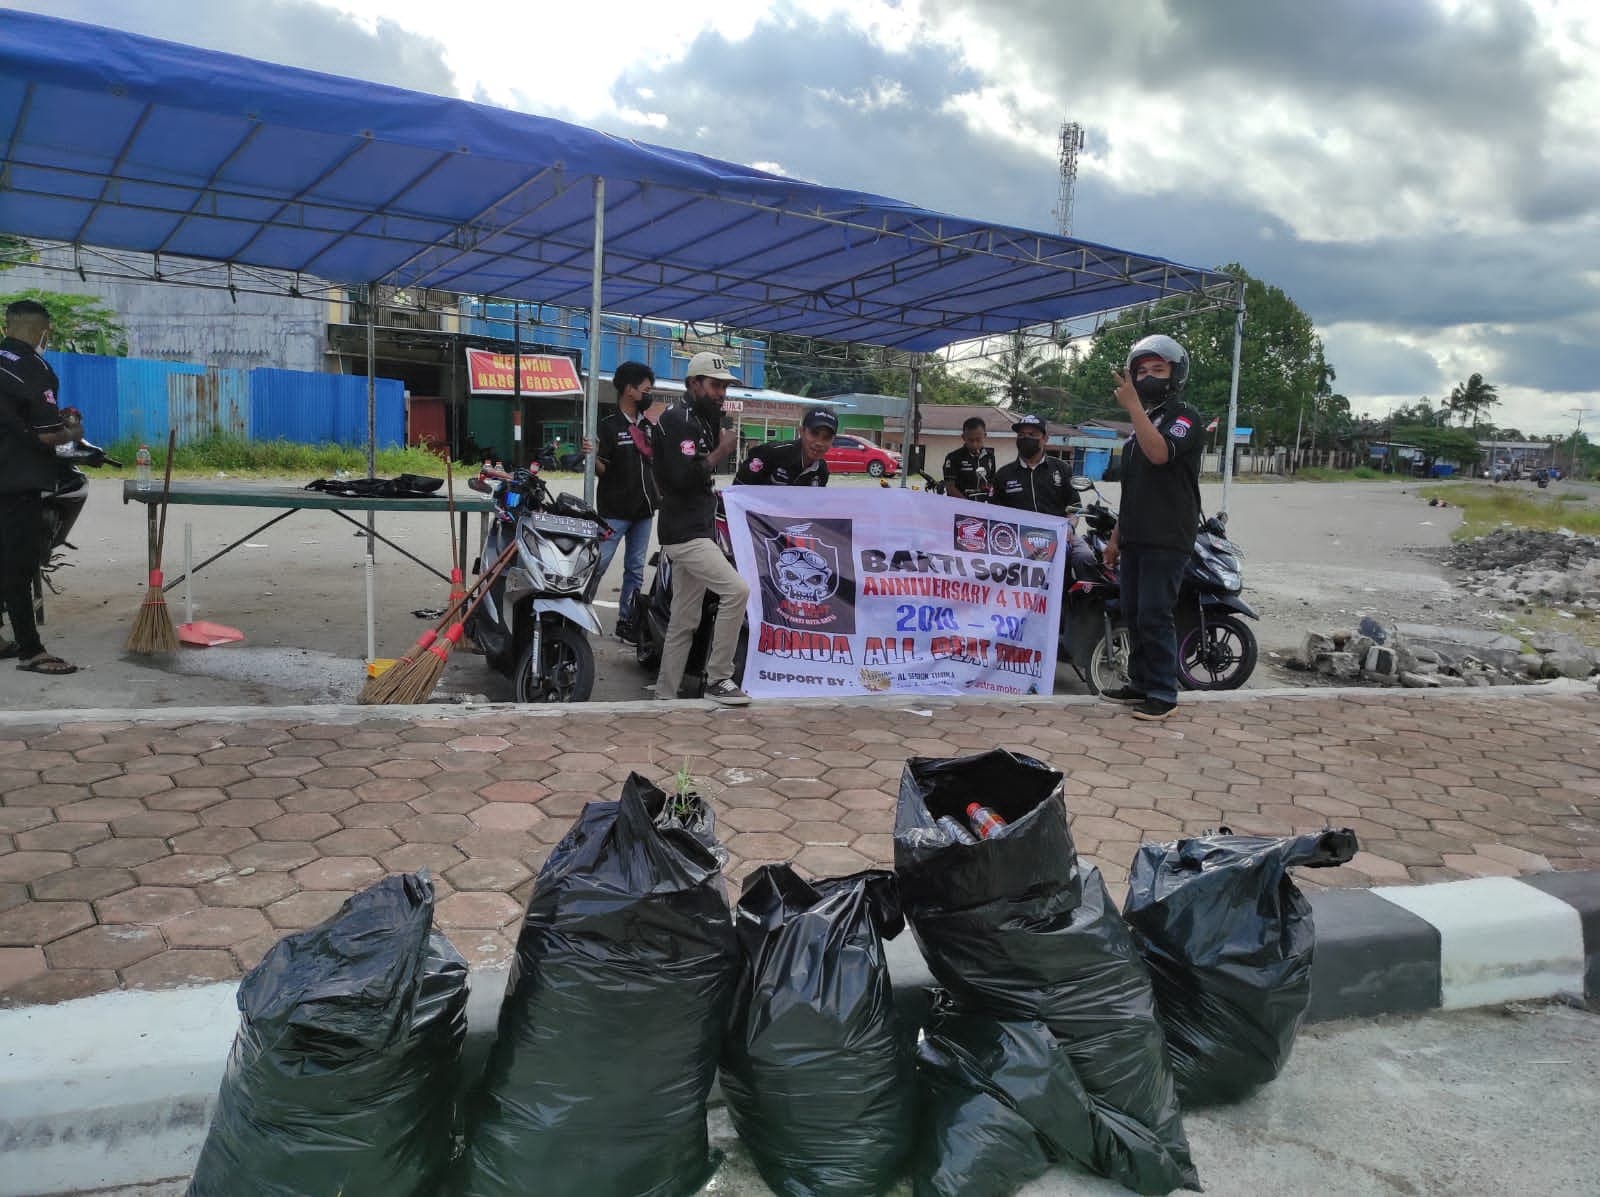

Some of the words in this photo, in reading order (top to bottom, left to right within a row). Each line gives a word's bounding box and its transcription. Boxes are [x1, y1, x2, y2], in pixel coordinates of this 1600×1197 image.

[492, 355, 553, 373] MEAYANI
[860, 549, 967, 577] BAKTI
[862, 576, 991, 604] ANNIVERSARY
[996, 588, 1008, 608] 4
[758, 621, 854, 666] HONDA
[864, 636, 925, 666] ALL
[758, 669, 824, 686] SUPPORT
[826, 676, 846, 688] BY
